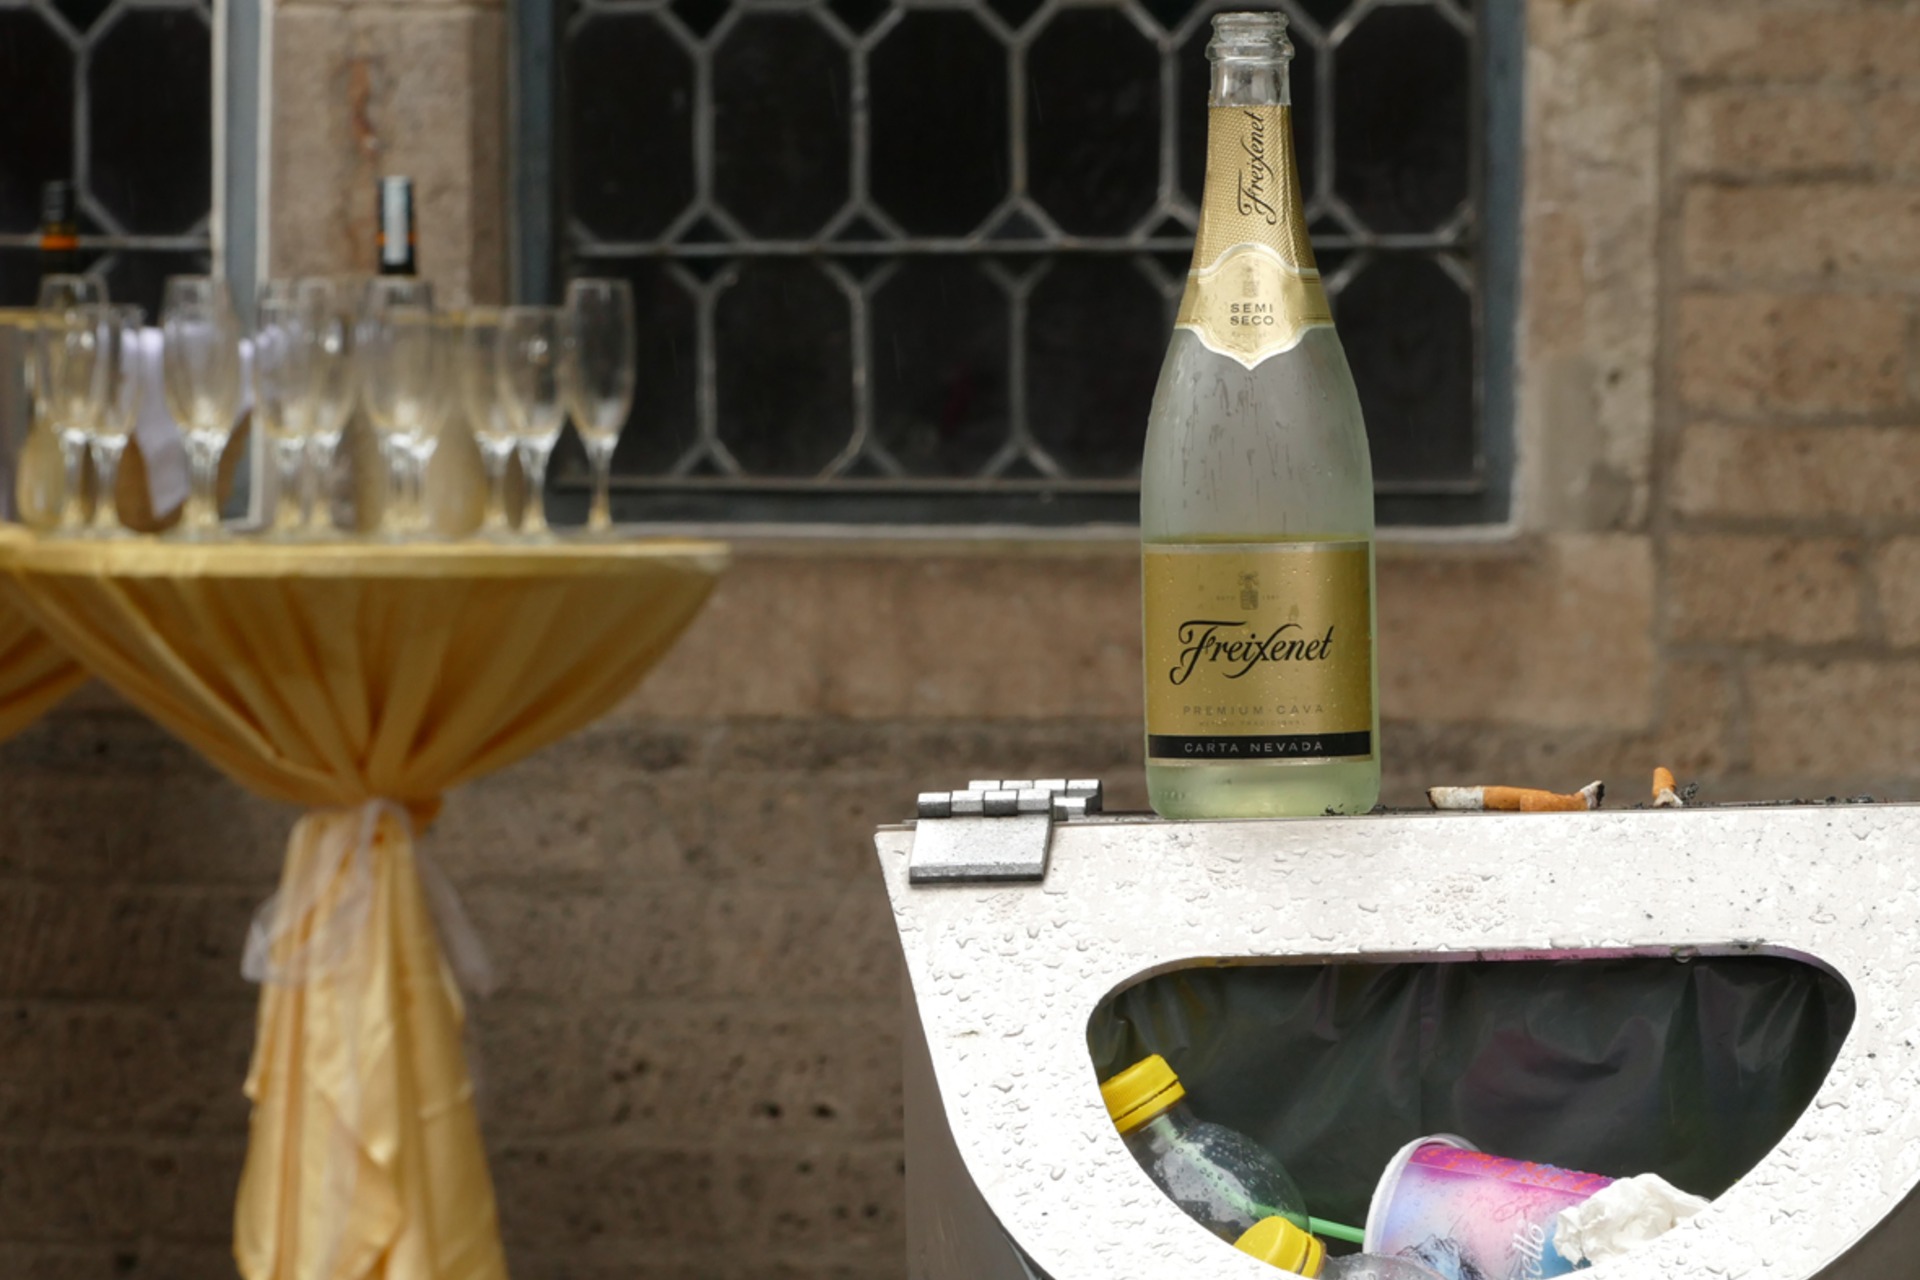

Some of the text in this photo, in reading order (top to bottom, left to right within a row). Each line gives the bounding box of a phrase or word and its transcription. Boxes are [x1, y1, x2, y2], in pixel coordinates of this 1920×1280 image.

[1237, 110, 1277, 225] Freixenet
[1230, 303, 1273, 313] SEMI
[1230, 315, 1274, 326] SECO
[1169, 619, 1335, 686] Freixenet
[1183, 704, 1324, 716] PREMIUM CAVA
[1184, 741, 1323, 753] CARTA NEVADA
[1511, 1222, 1546, 1280] ello
